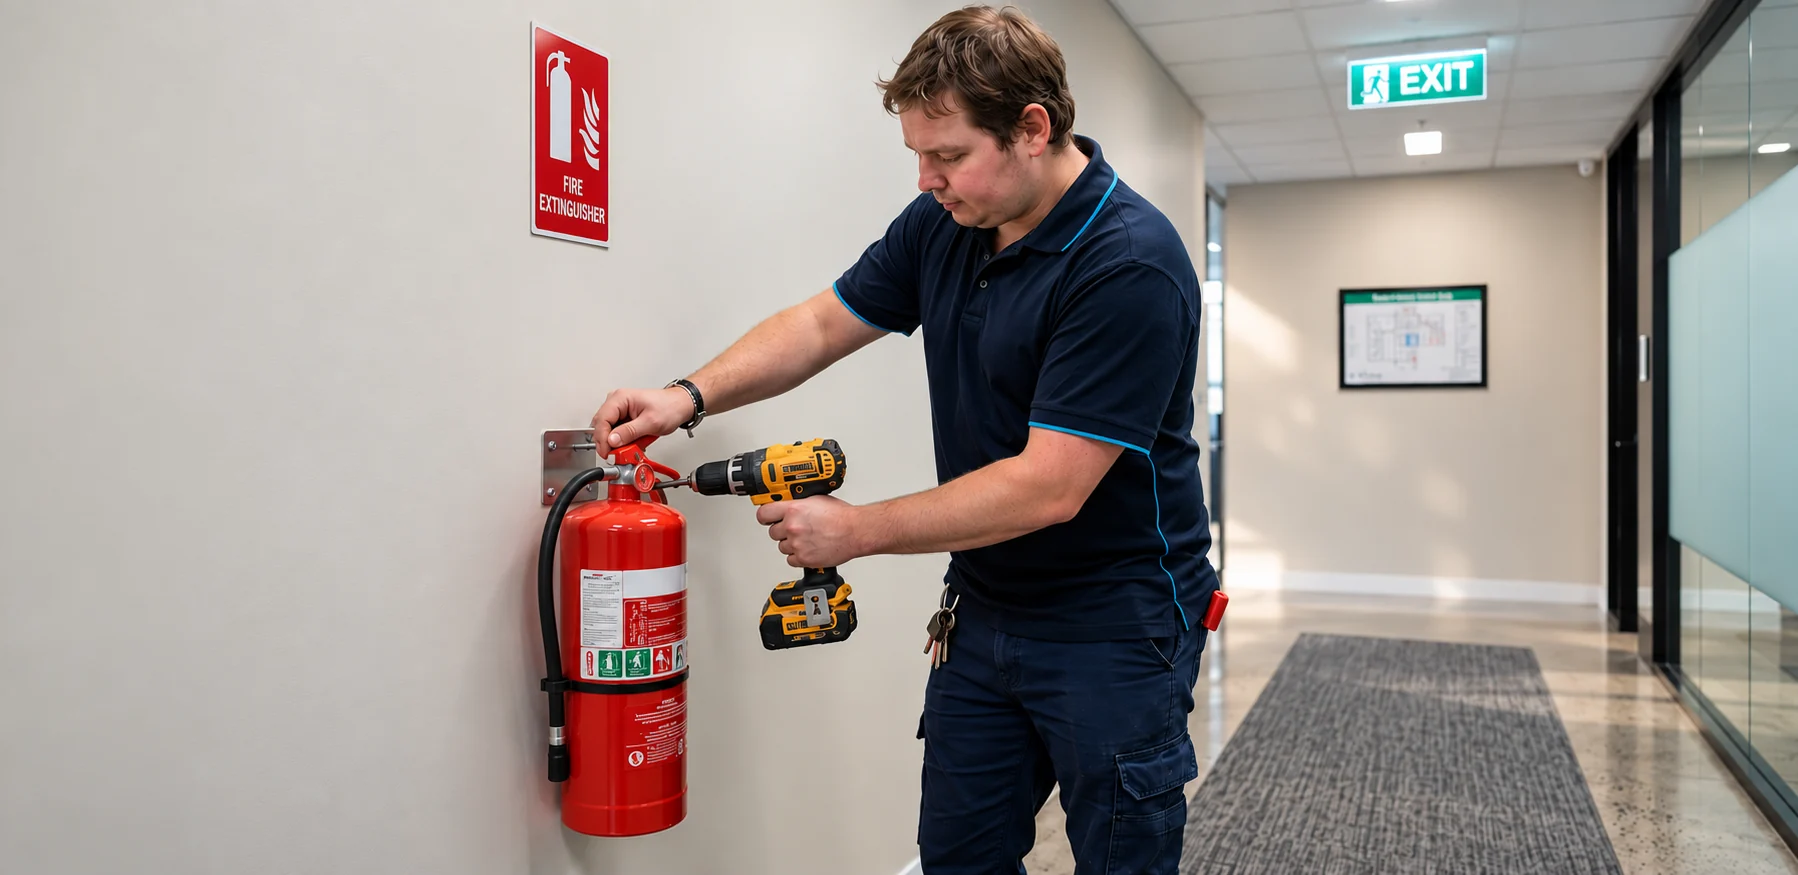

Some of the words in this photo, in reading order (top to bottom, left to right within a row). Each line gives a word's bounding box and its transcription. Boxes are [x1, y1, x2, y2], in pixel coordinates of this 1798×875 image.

[1400, 60, 1474, 95] EXIT
[563, 175, 583, 196] FIRE
[539, 192, 605, 224] EXTINGUISHER
